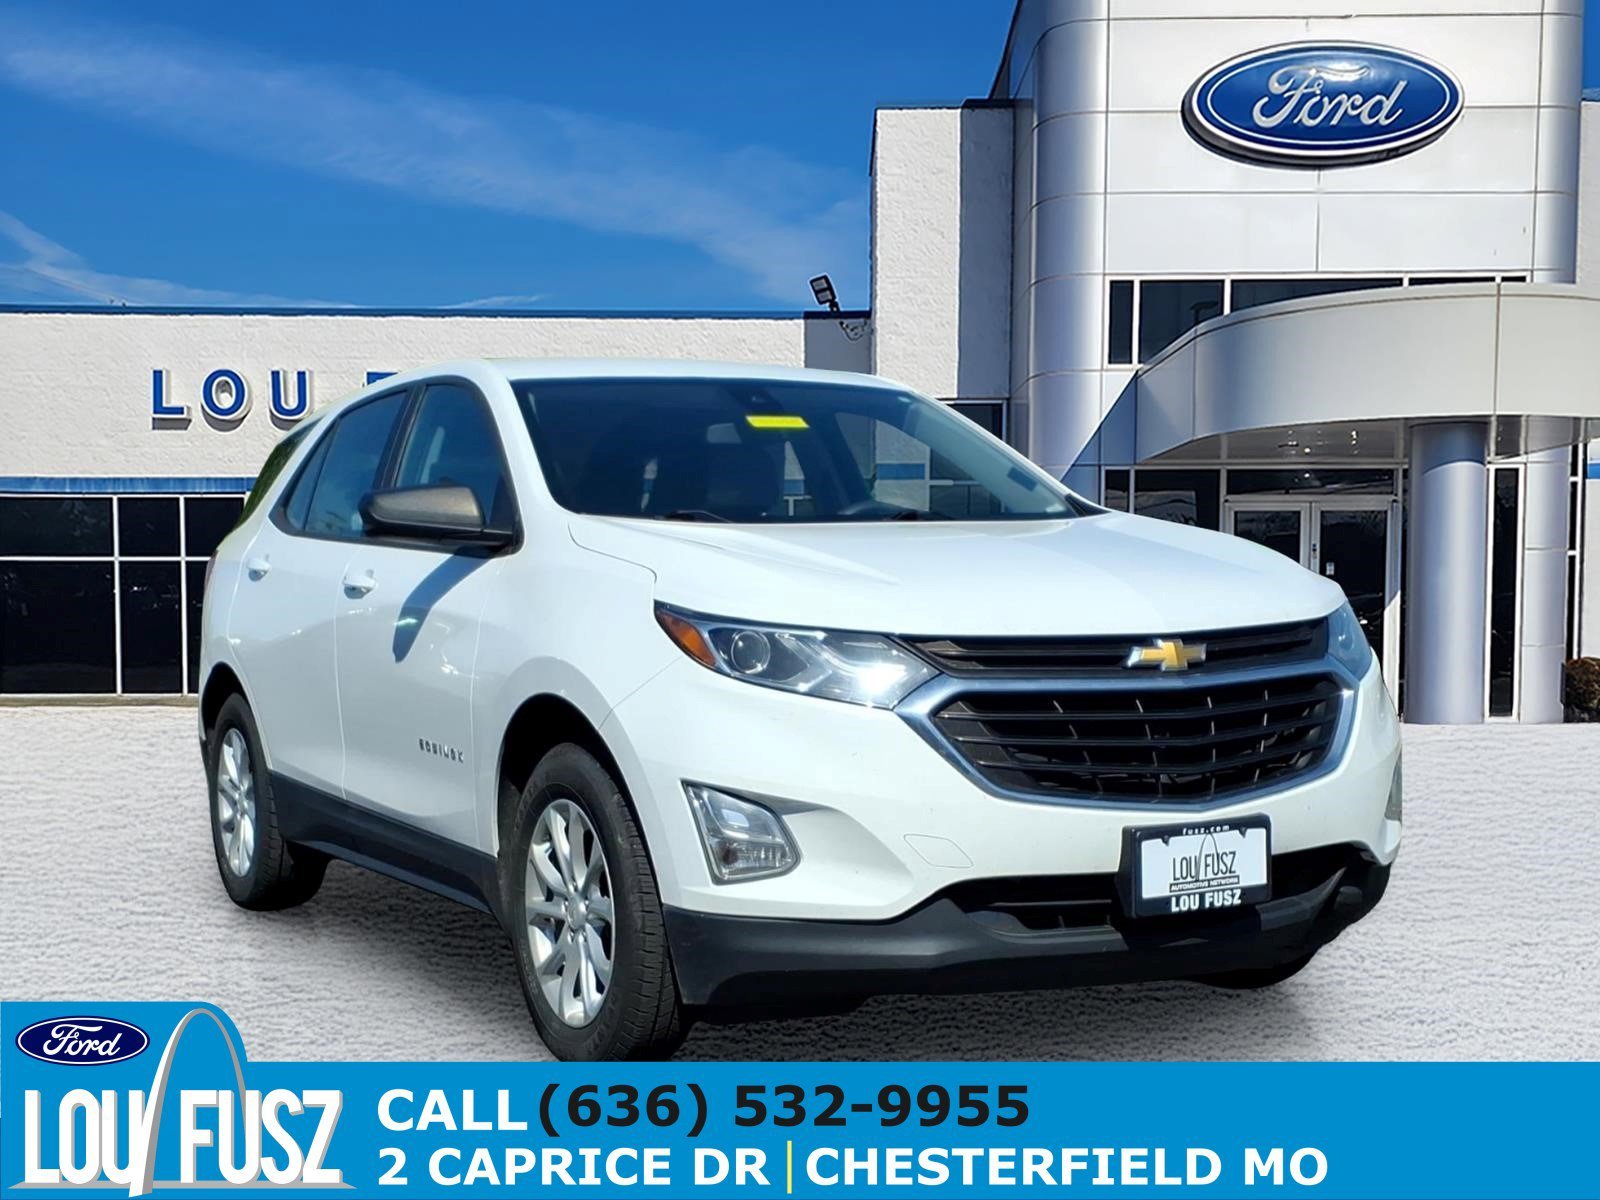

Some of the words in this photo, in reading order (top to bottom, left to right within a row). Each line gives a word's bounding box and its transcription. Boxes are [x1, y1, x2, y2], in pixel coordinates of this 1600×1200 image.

[1252, 63, 1408, 128] Ford
[152, 367, 312, 419] LOU
[1173, 856, 1200, 881] LOU
[1205, 851, 1236, 877] FUSZ
[1171, 894, 1200, 912] LOU
[1205, 889, 1241, 908] FUSZ
